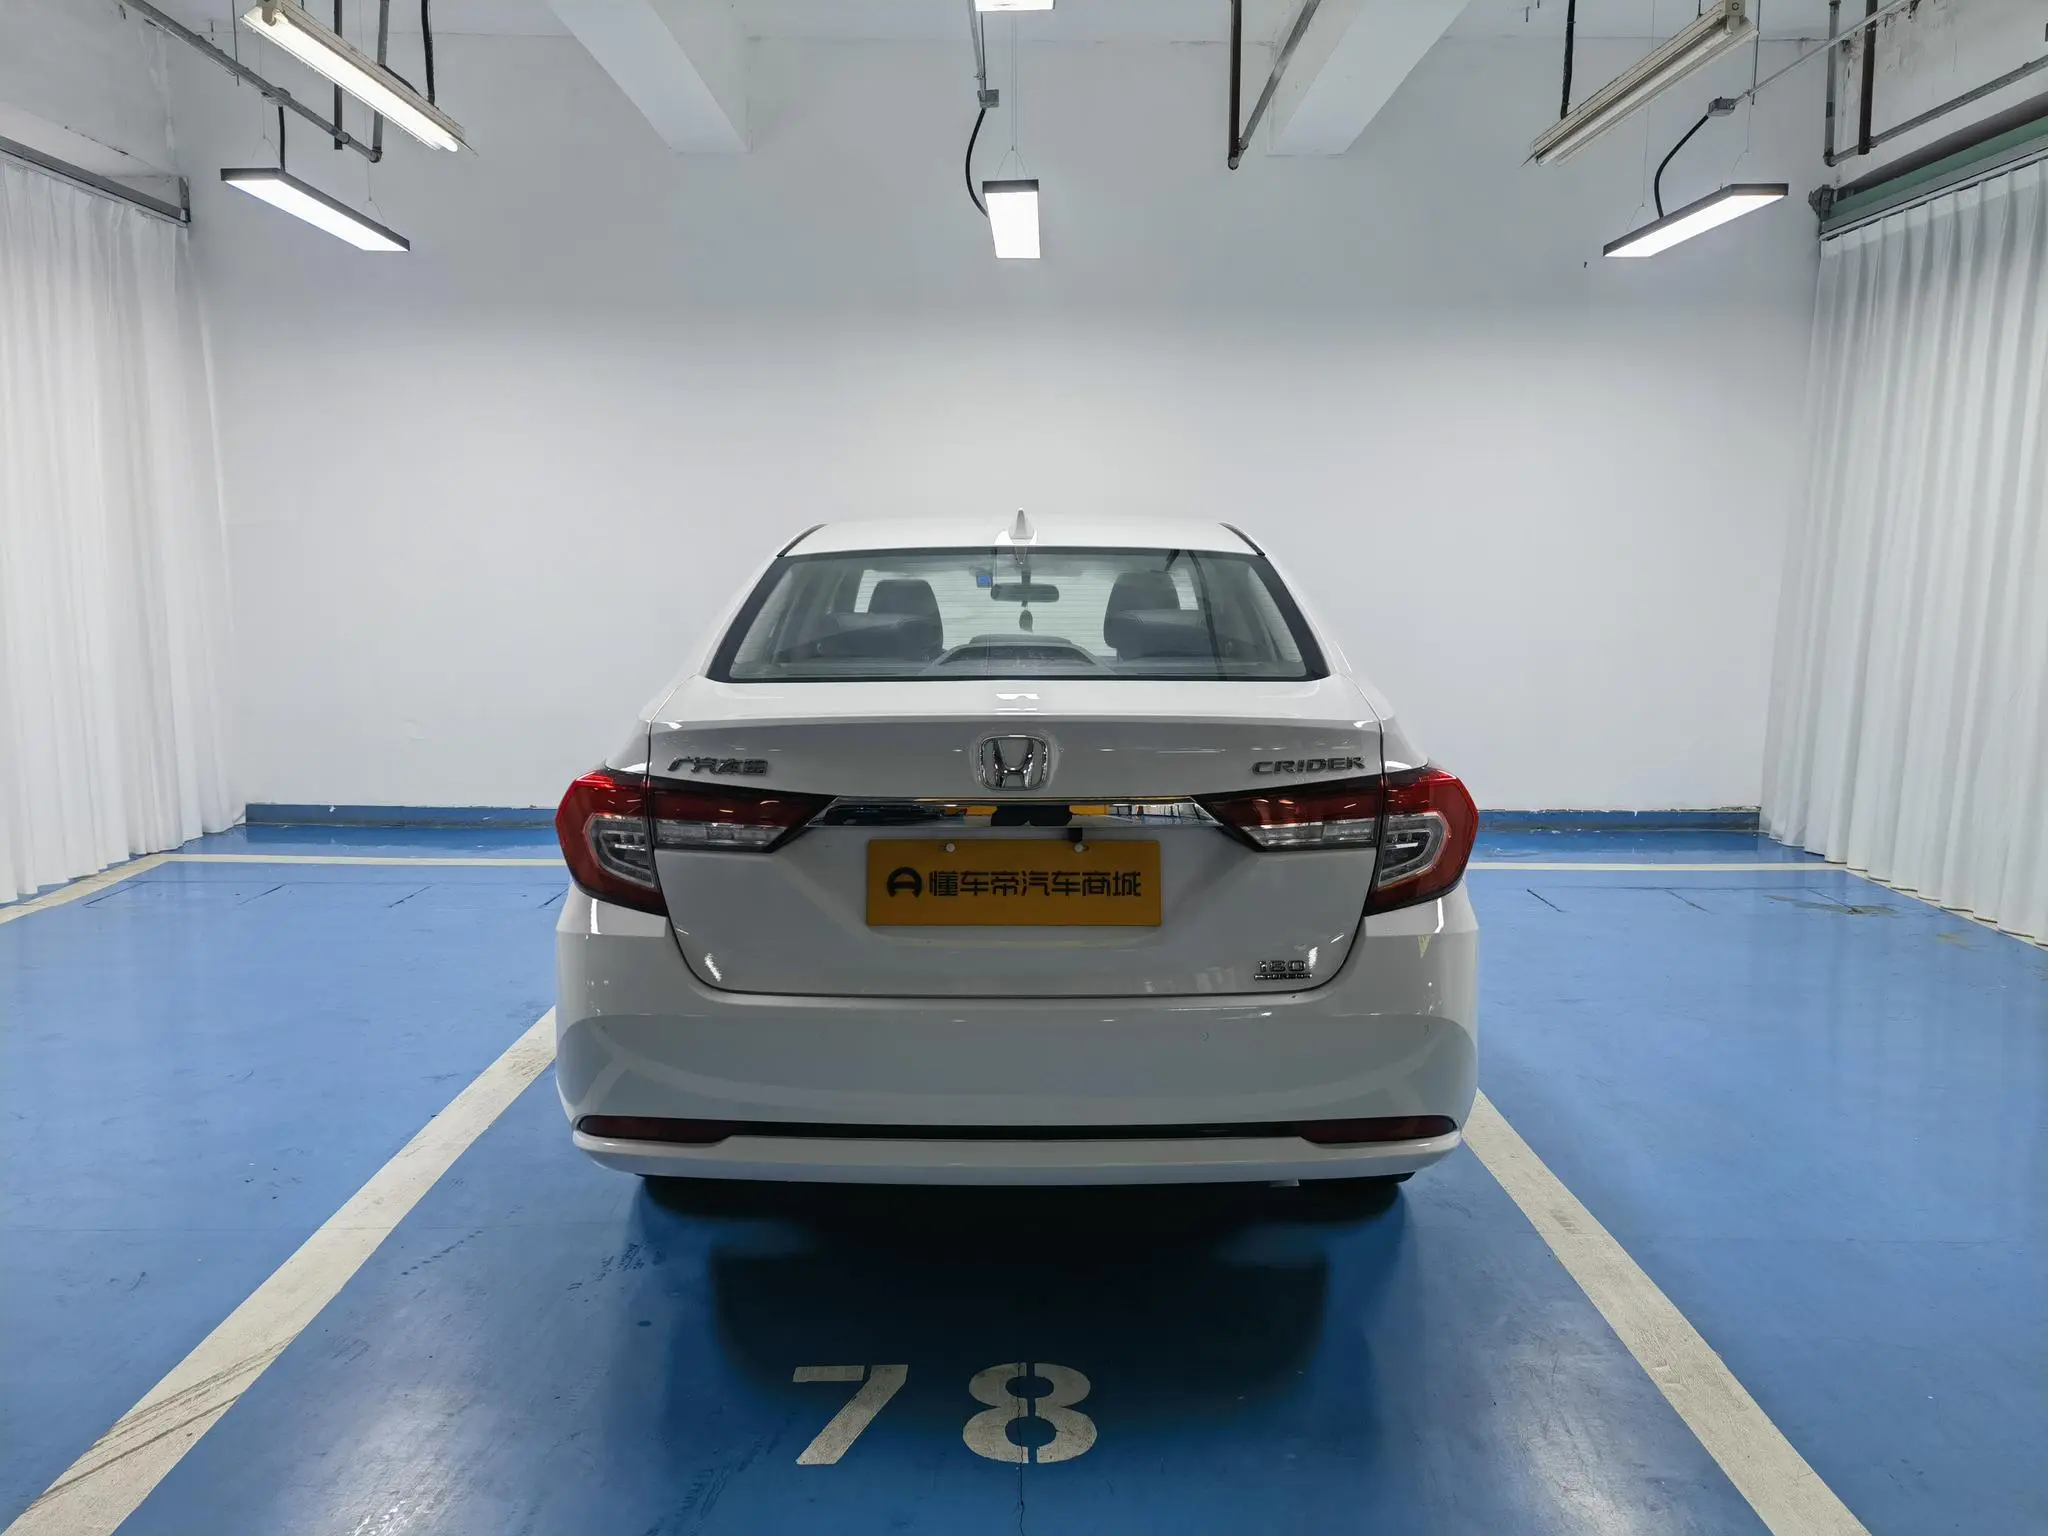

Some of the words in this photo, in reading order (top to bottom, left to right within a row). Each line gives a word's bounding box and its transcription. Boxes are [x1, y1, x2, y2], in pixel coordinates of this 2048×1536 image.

[1252, 756, 1366, 775] CRIDER
[928, 870, 1142, 897] 懂车帝汽车商城
[793, 1362, 1098, 1465] 78
